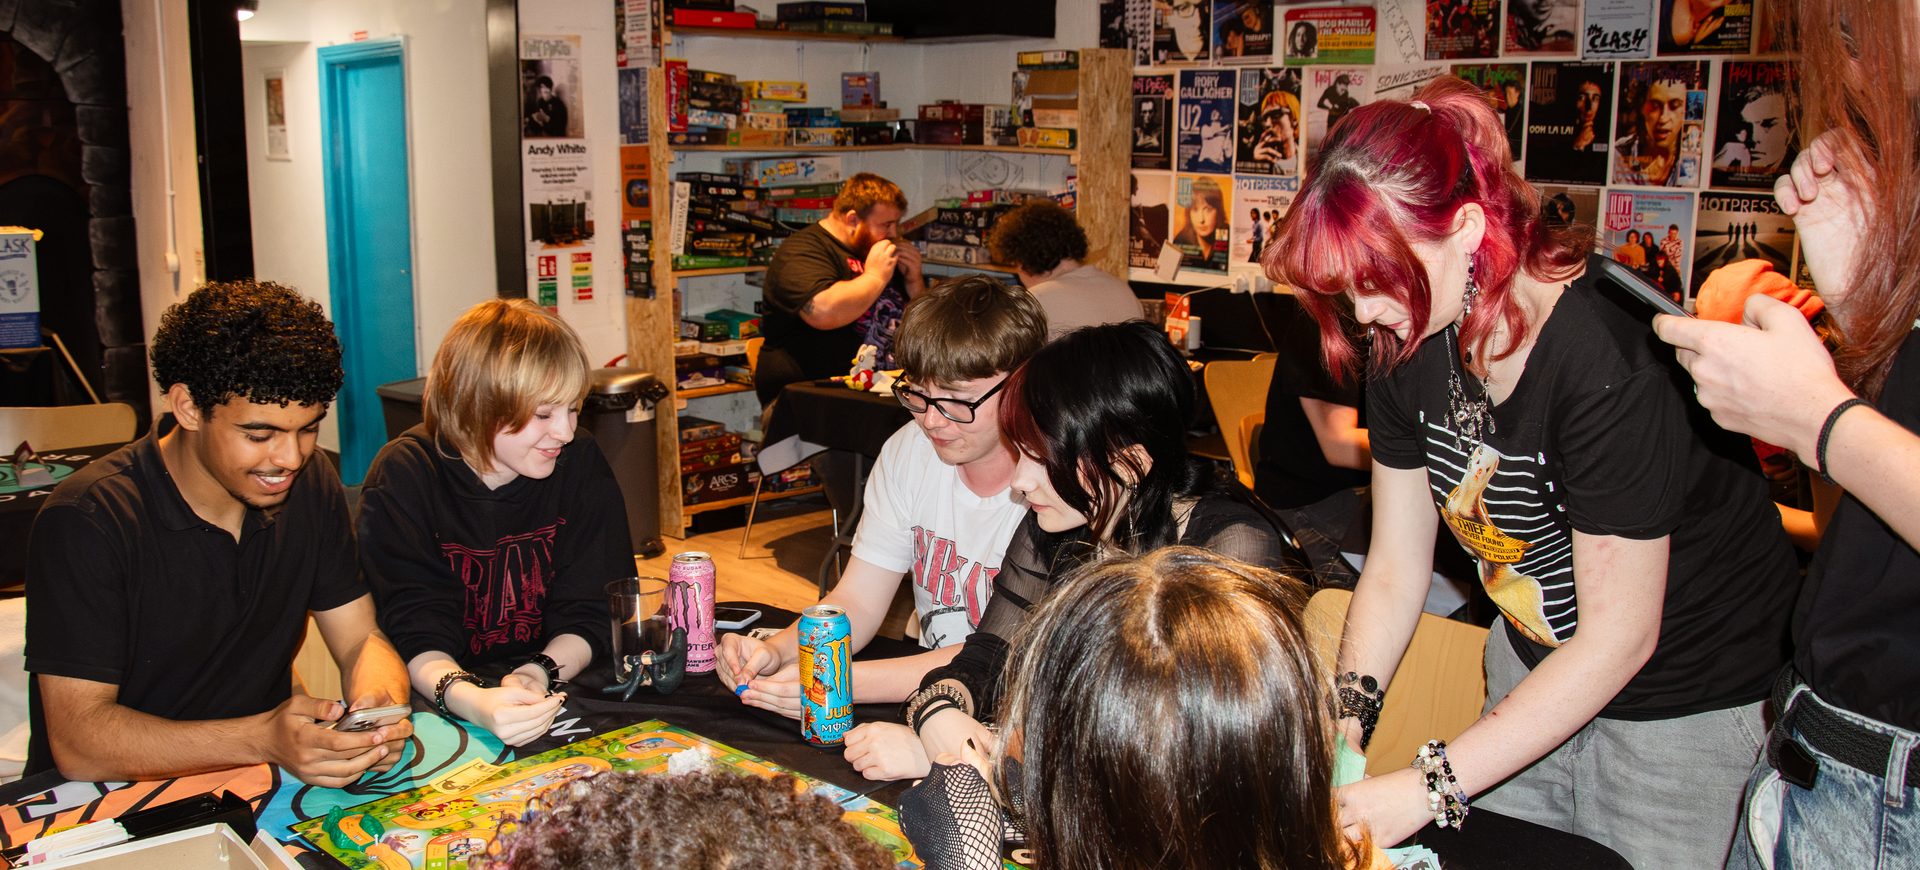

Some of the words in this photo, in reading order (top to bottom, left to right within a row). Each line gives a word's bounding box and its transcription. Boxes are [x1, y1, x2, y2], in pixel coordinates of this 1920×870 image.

[1590, 28, 1648, 49] CLASH
[1194, 76, 1219, 87] RORY
[1377, 72, 1410, 88] SONIC
[1181, 87, 1233, 99] GALLAGHER
[1181, 104, 1202, 131] U2
[1529, 125, 1545, 134] OOH
[1548, 126, 1559, 134] LA
[1561, 126, 1573, 135] LA!
[528, 144, 554, 156] Andy
[556, 144, 587, 155] White
[1700, 197, 1780, 214] HOTPRESS
[709, 473, 738, 489] ARCS
[1457, 519, 1486, 536] THIEF
[1461, 530, 1480, 540] NEVER
[1481, 535, 1505, 547] FOUND
